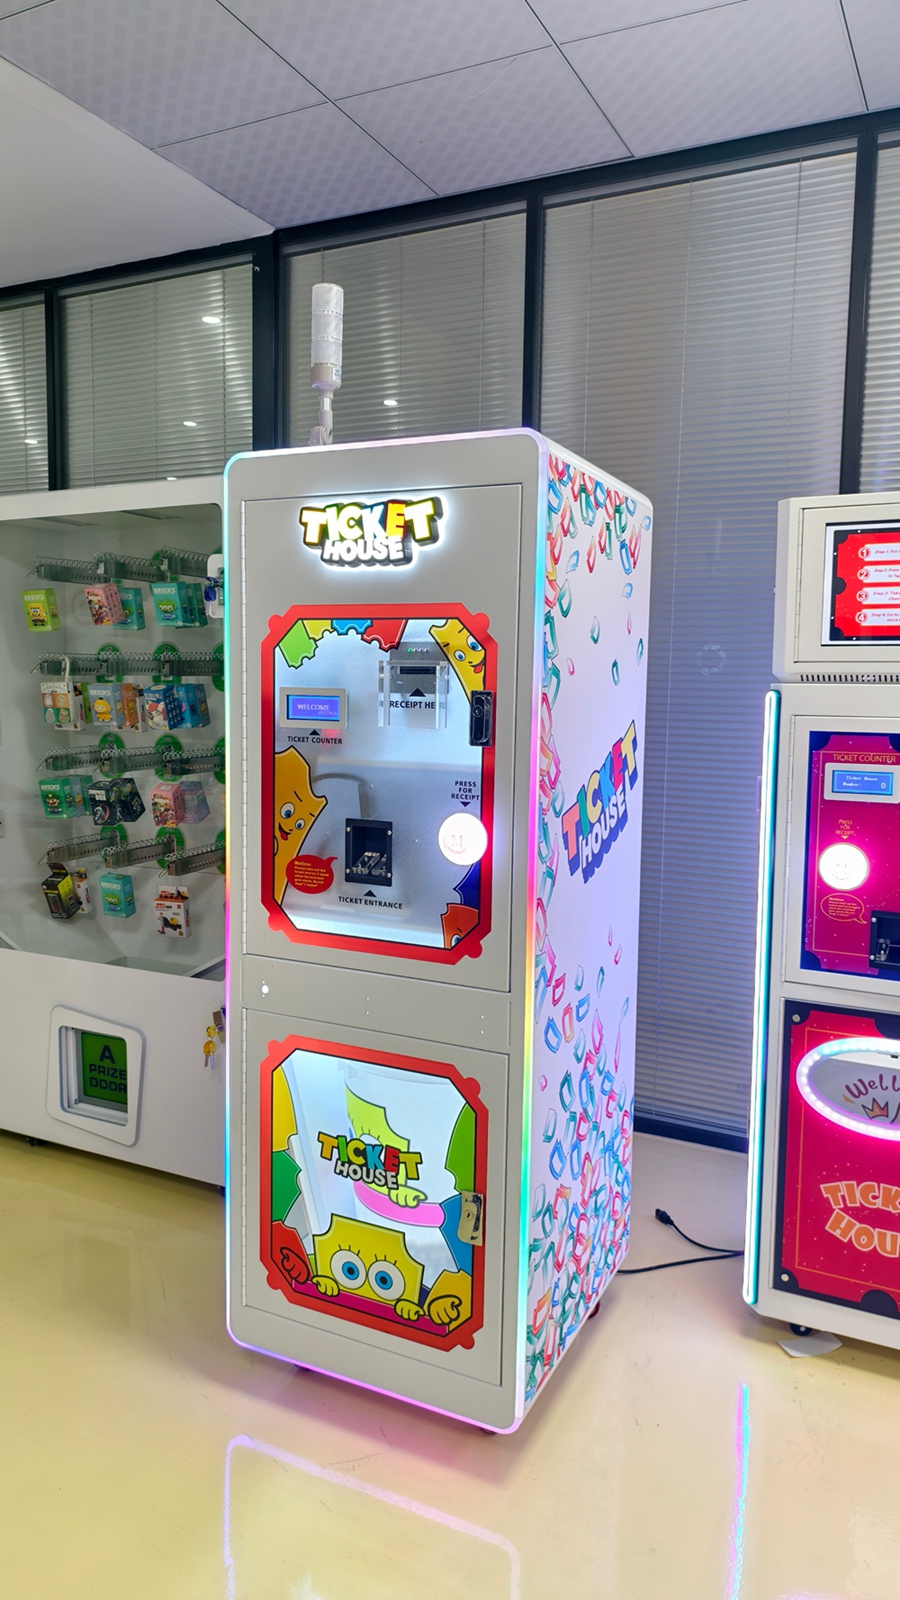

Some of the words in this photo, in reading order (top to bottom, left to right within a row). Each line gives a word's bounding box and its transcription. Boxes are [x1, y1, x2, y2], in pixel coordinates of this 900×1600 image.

[299, 497, 442, 546] TICKET
[321, 534, 409, 565] HOUSE
[390, 700, 422, 709] RECEIPT
[833, 754, 858, 762] TICKET
[859, 754, 896, 763] COUNTER
[562, 720, 637, 872] TICKET
[581, 783, 627, 876] HOUSE
[338, 896, 363, 904] TICKET
[364, 899, 403, 909] ENTRANCE
[99, 1045, 116, 1064] A
[88, 1063, 127, 1080] PRIZE
[89, 1076, 127, 1094] DOOR
[317, 1131, 423, 1180] TICKET
[334, 1160, 399, 1190] HOUSE
[825, 1208, 900, 1258] HOU
